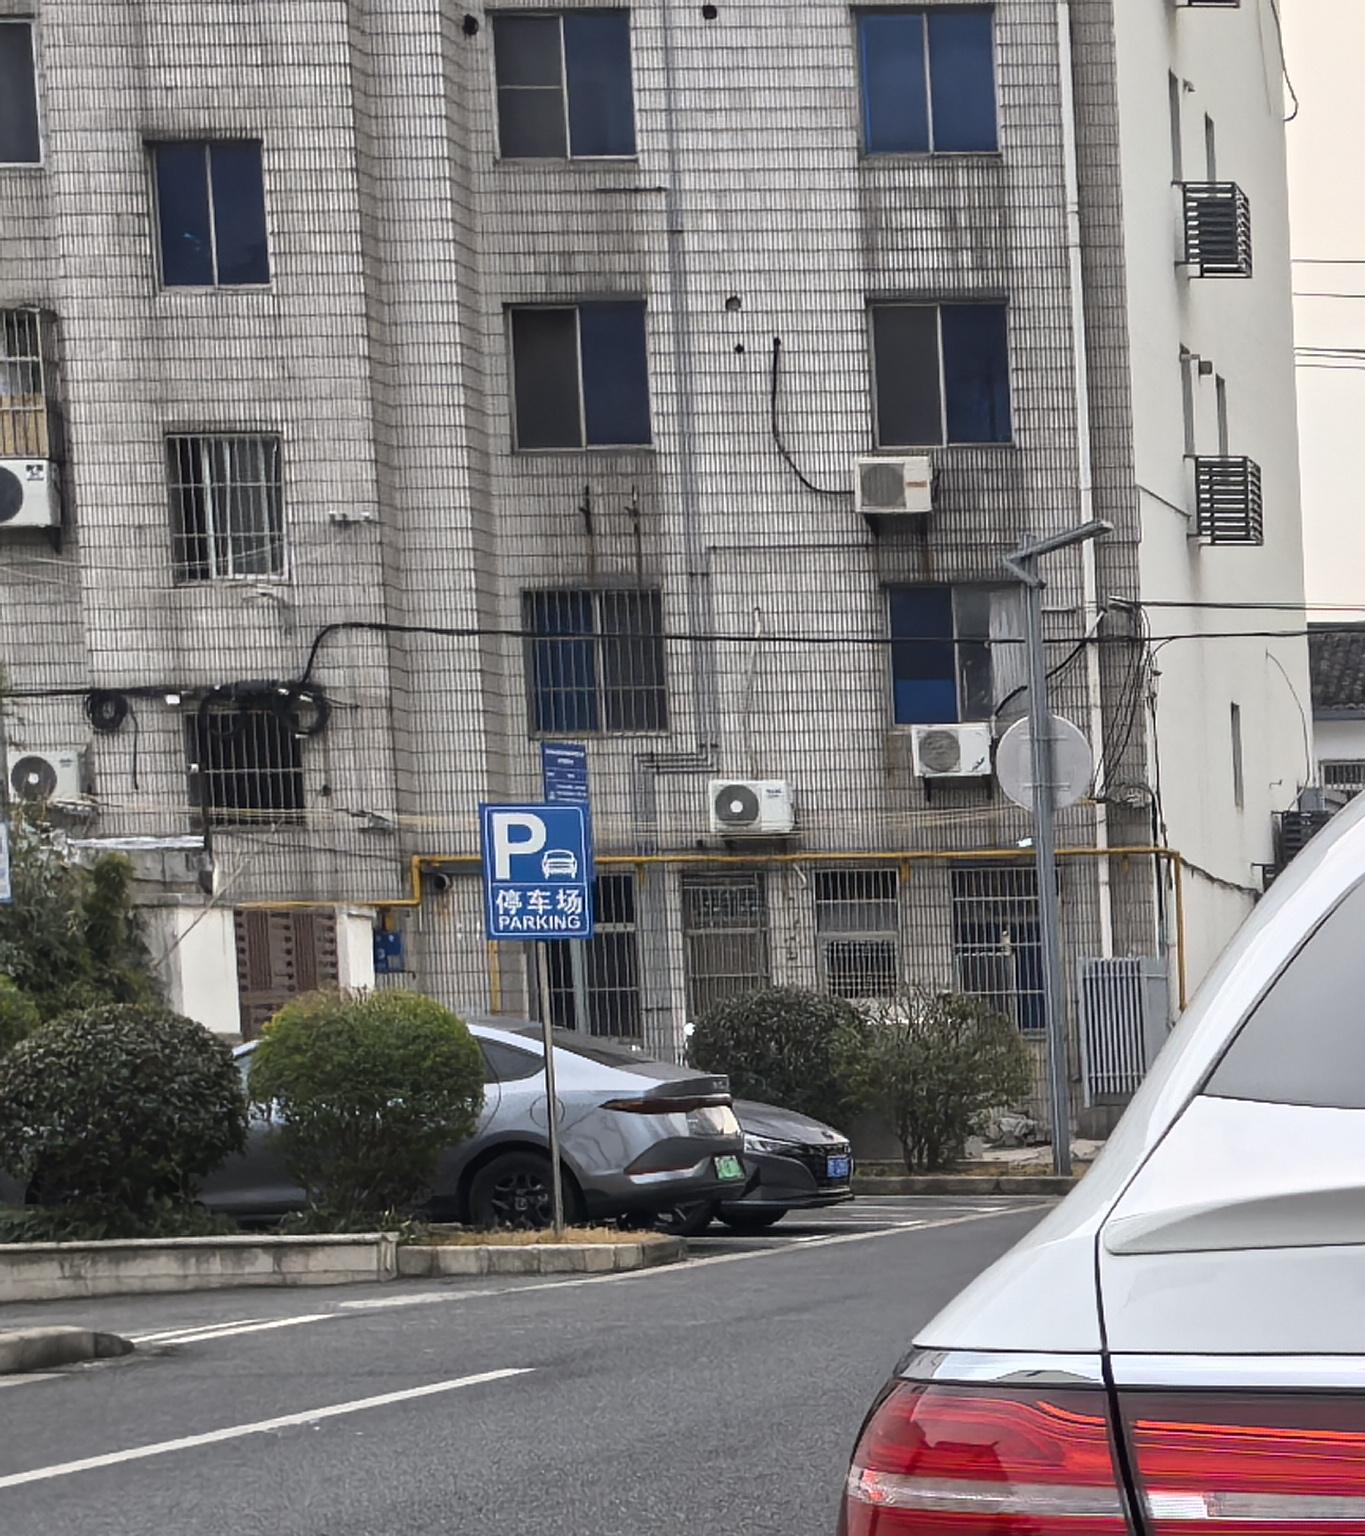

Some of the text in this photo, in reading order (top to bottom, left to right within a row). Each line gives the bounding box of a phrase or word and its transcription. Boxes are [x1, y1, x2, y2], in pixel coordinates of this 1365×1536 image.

[492, 812, 546, 880] P
[496, 889, 582, 915] 停车场
[499, 915, 581, 930] PARKING
